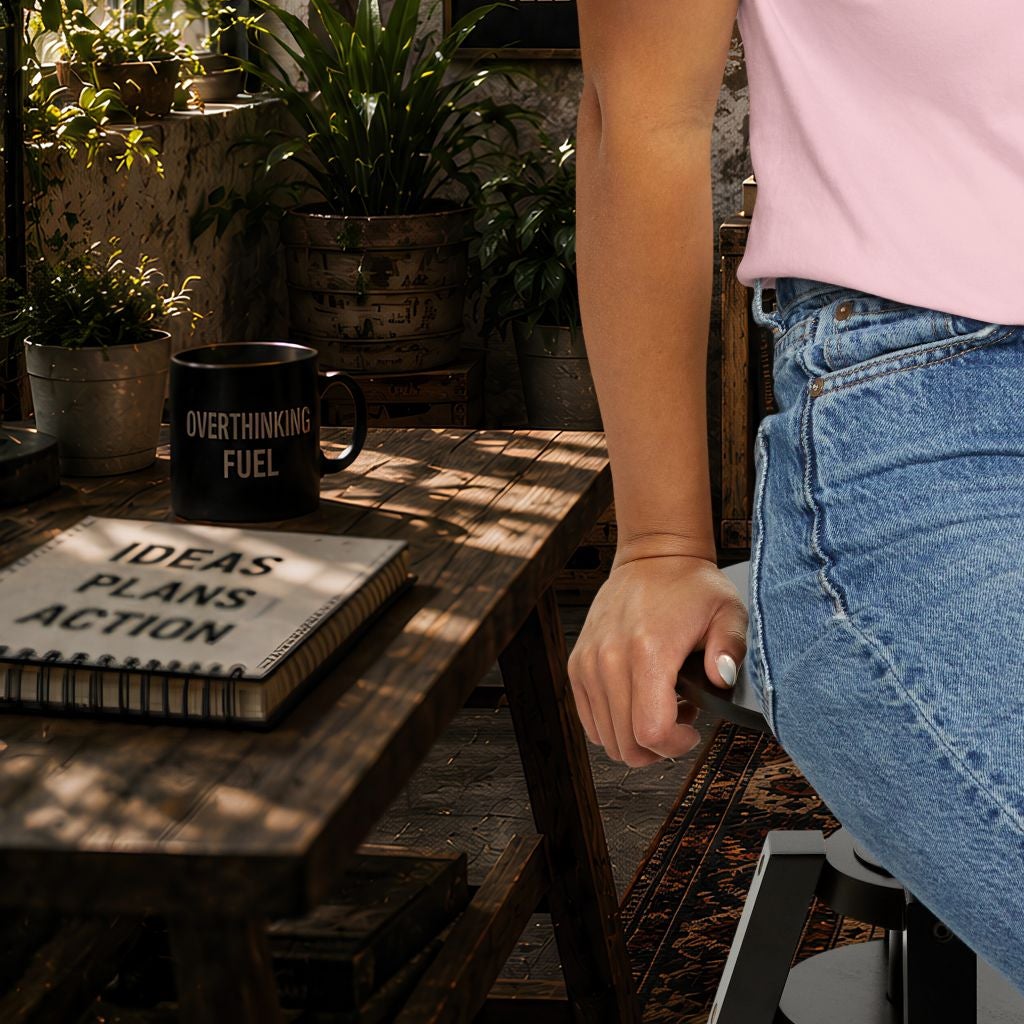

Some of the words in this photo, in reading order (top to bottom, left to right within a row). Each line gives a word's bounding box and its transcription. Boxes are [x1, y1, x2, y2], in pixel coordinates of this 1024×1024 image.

[186, 406, 311, 440] OVERTHINKING
[223, 448, 279, 479] FUEL
[110, 542, 284, 576] IDEAS
[75, 573, 257, 610] PLANS
[14, 603, 236, 646] ACTION
